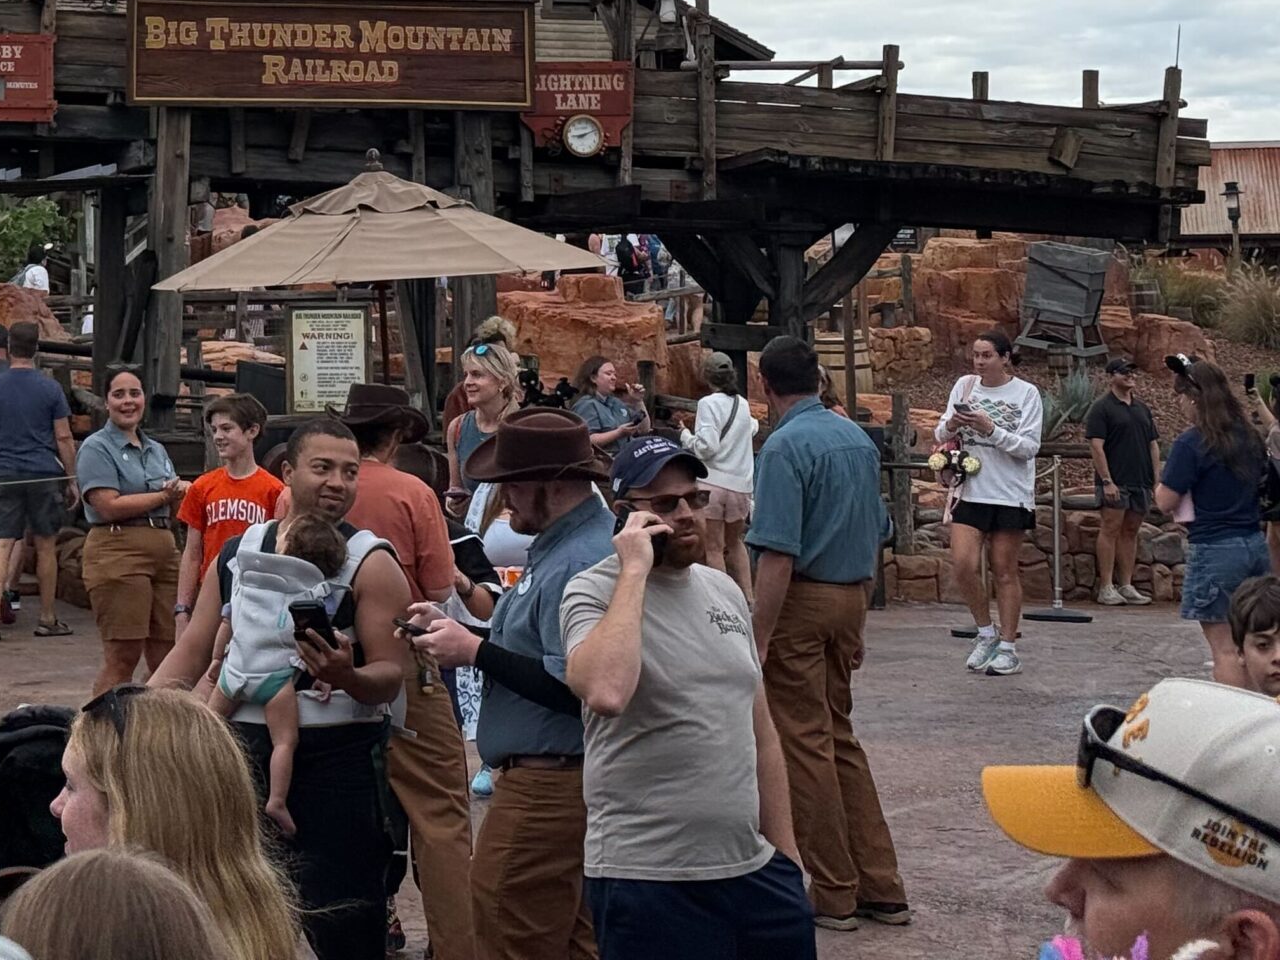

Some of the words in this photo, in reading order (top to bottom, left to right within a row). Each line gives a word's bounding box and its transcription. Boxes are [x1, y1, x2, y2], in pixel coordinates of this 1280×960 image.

[144, 16, 199, 49] BIG
[205, 17, 355, 51] THUNDER
[358, 20, 513, 53] MOUNTAIN
[261, 55, 400, 84] RAILROAD
[6, 81, 38, 89] MINUTES
[555, 93, 601, 110] LANE
[301, 332, 354, 340] WARNING!
[205, 498, 267, 526] CLEMSON
[1191, 827, 1269, 870] REBELLION
[1202, 819, 1237, 840] JOIN
[1241, 834, 1268, 855] THE
